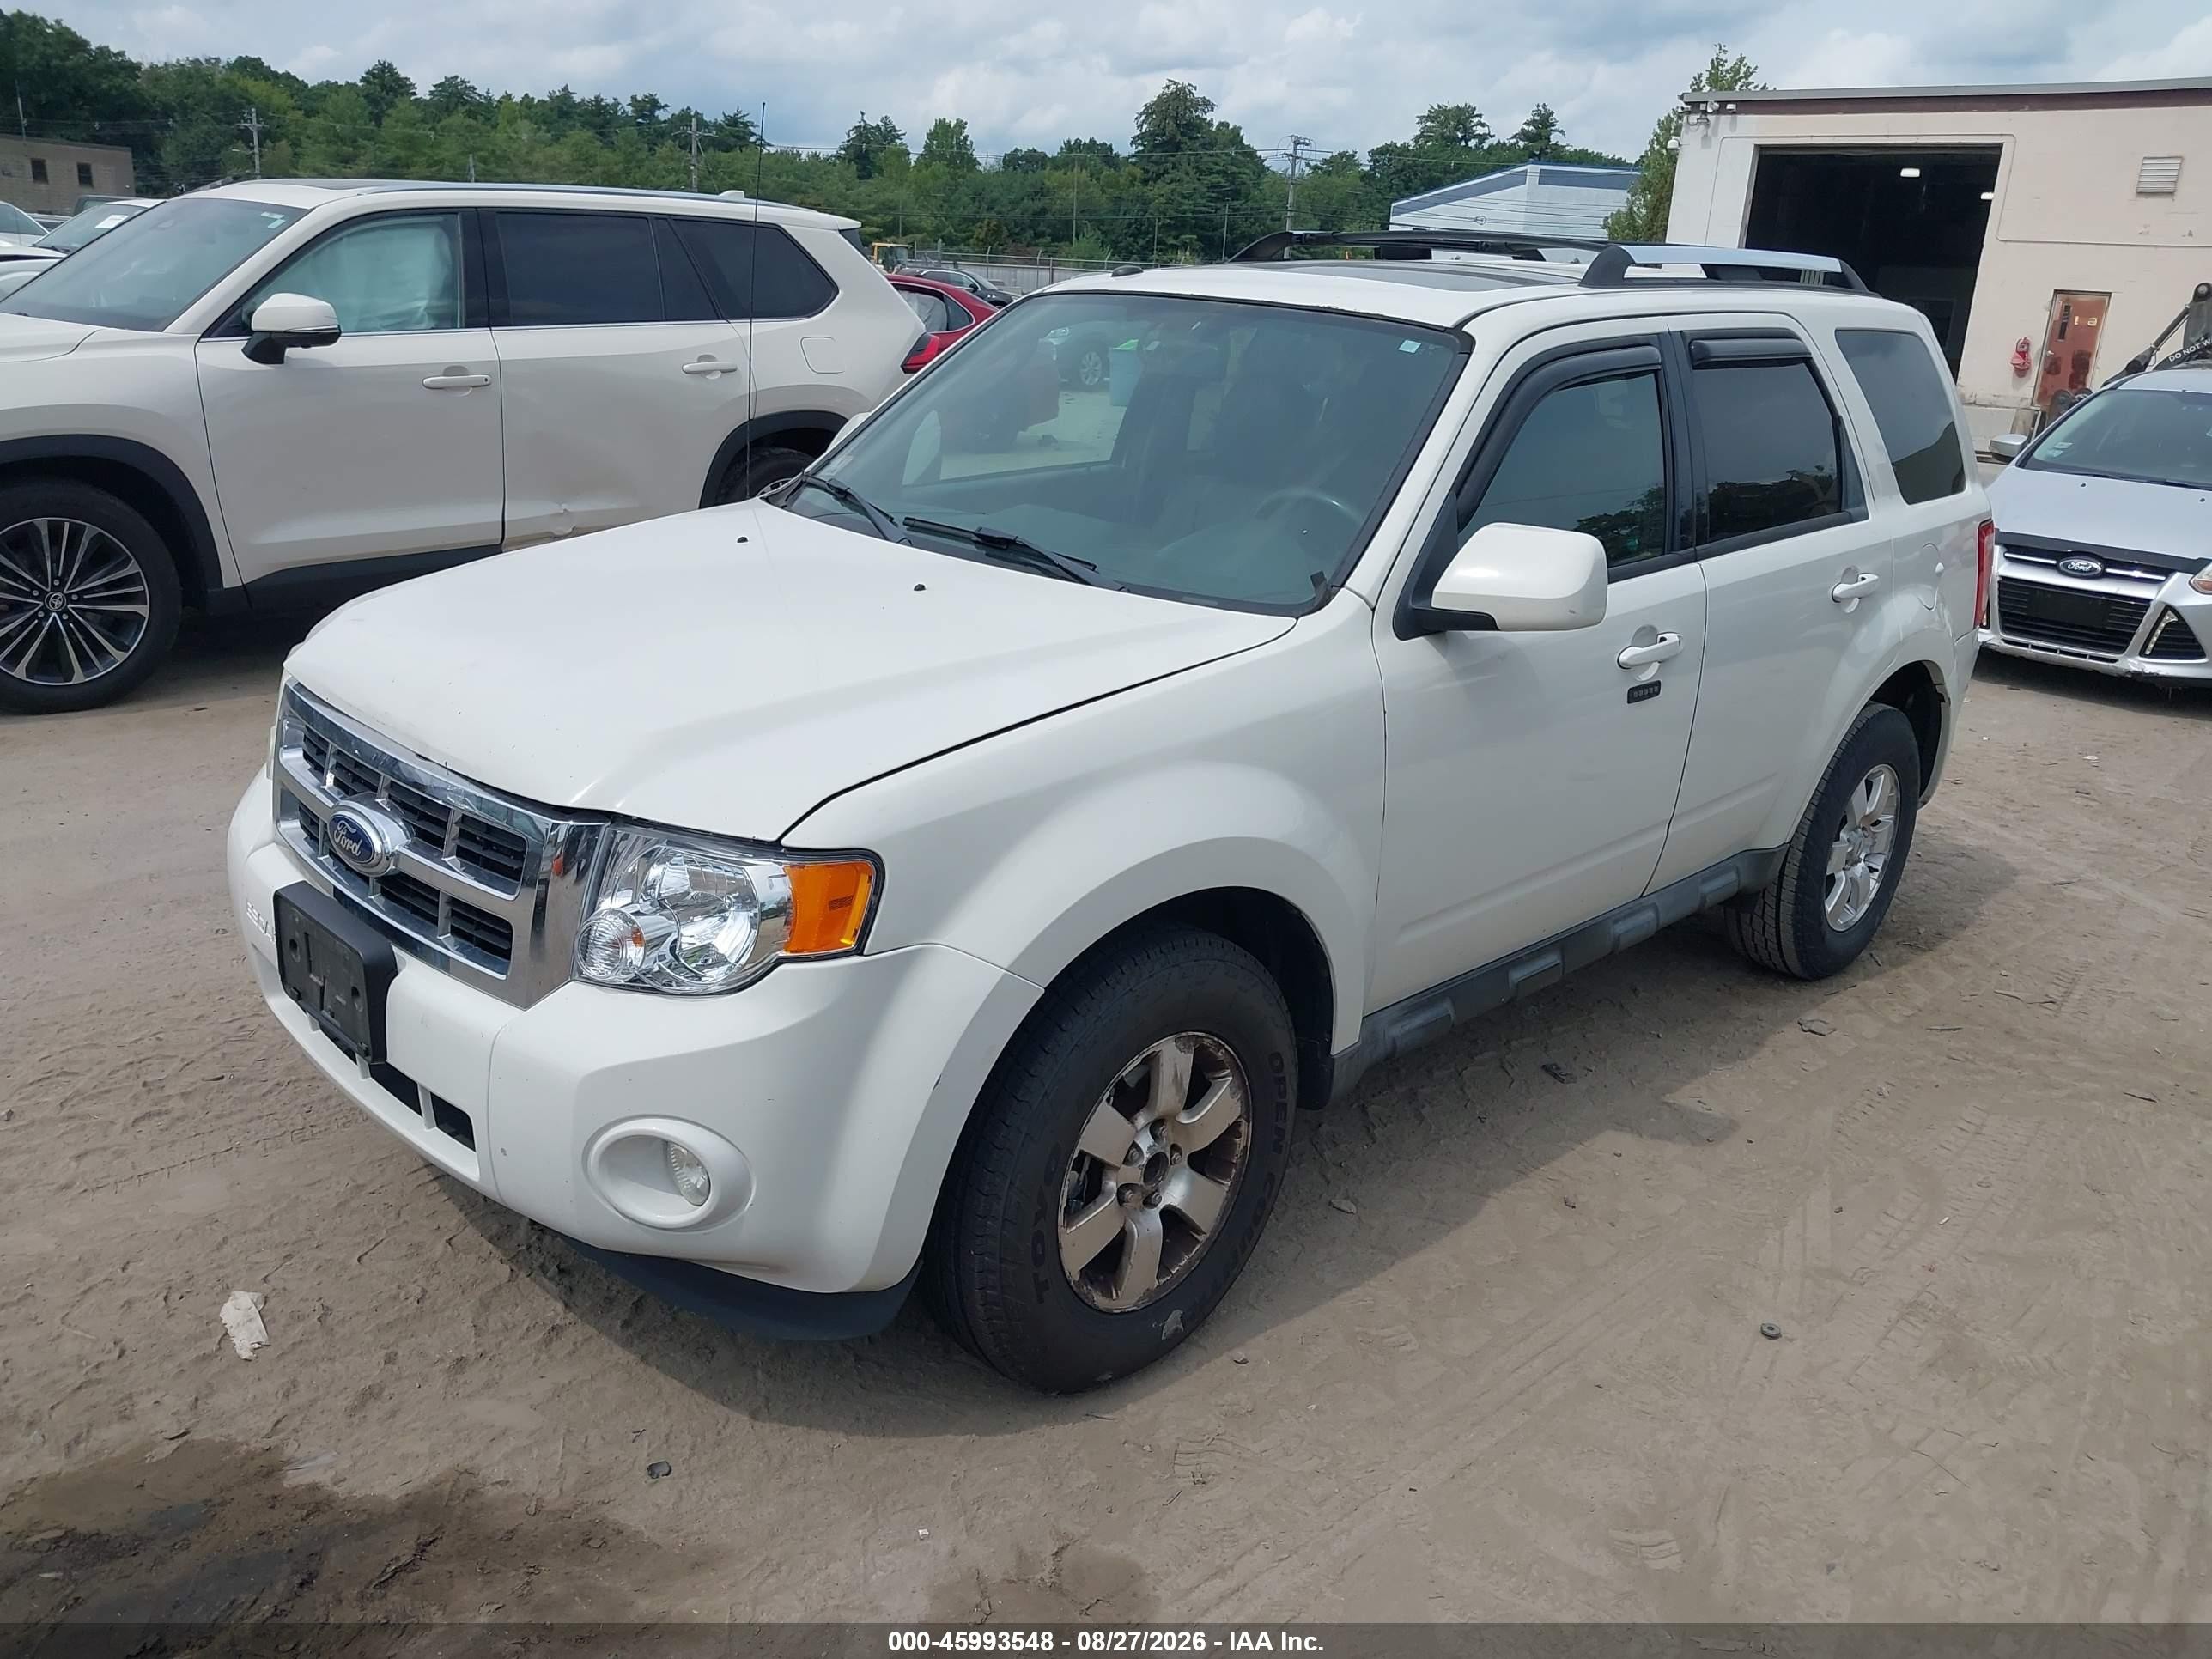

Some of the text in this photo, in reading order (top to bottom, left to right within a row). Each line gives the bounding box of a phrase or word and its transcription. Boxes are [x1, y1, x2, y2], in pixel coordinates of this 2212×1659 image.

[2169, 353, 2182, 362] DO
[2183, 343, 2201, 356] NOT
[2067, 561, 2092, 571] Ford
[334, 820, 363, 856] Ford
